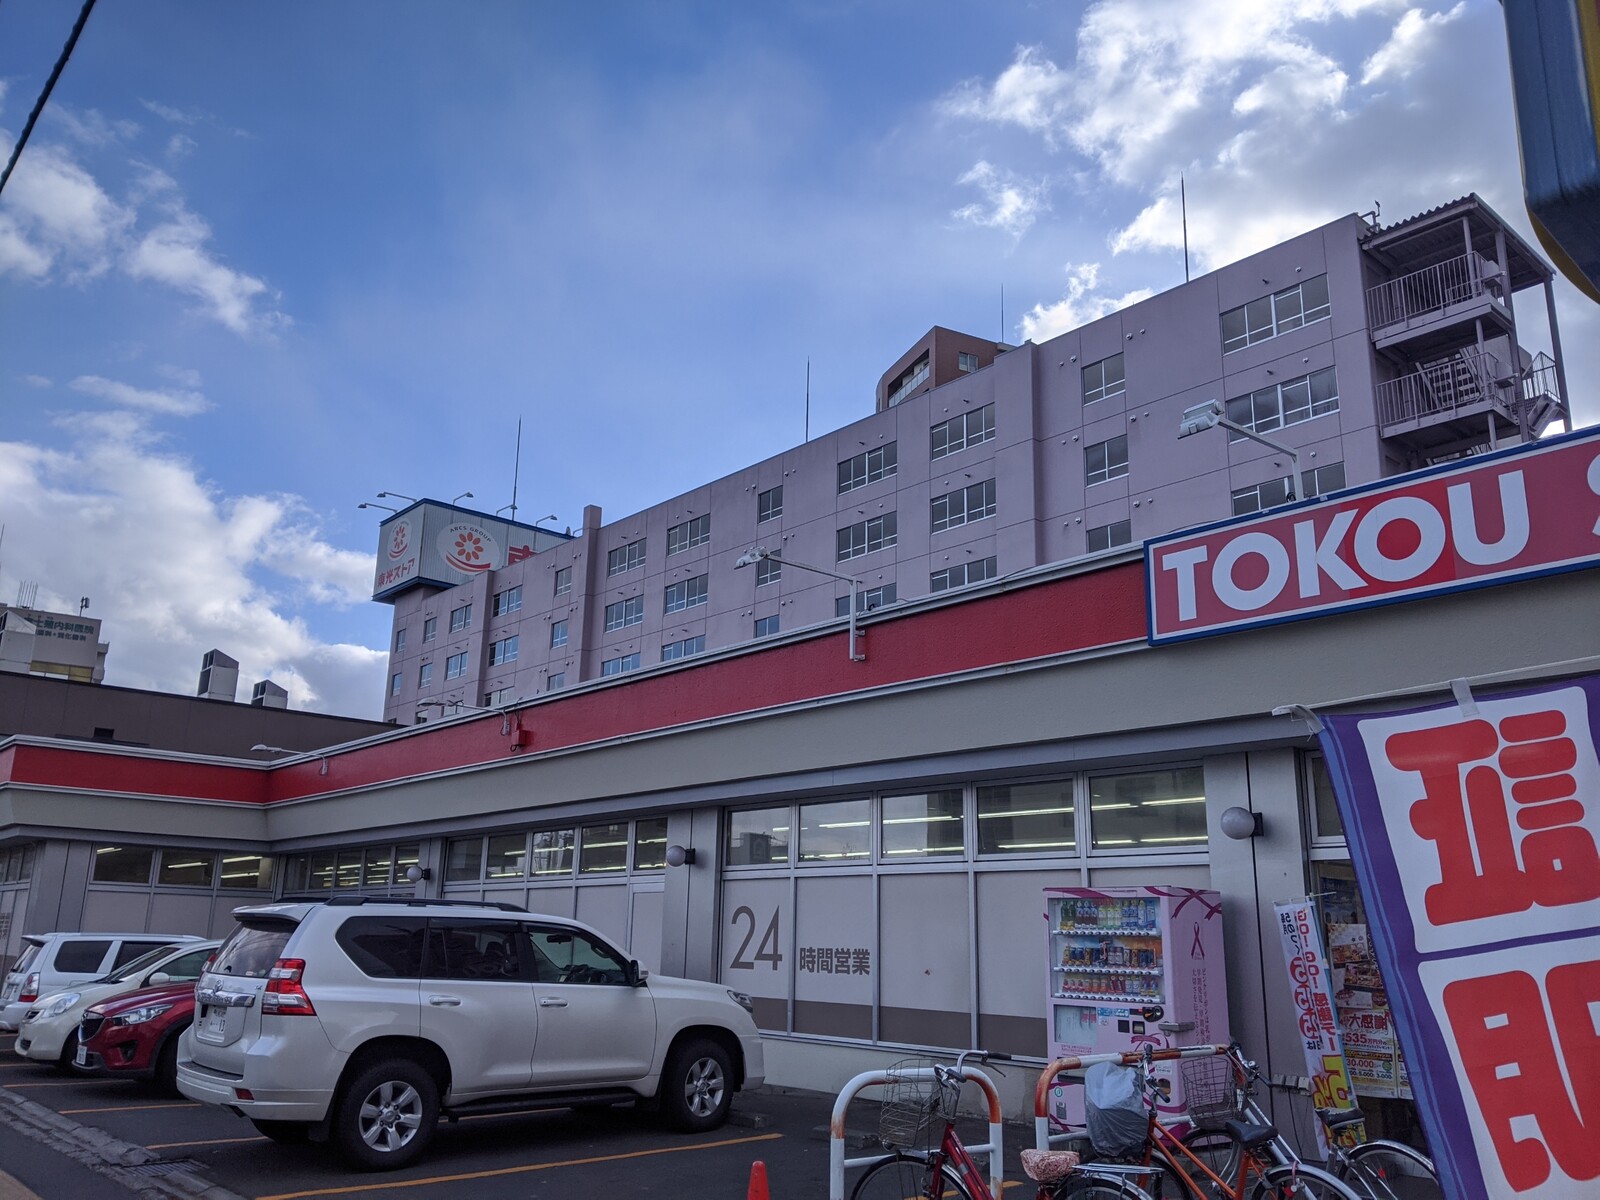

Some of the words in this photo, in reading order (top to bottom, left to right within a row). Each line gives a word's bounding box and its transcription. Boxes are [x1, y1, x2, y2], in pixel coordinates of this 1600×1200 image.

[450, 525, 467, 533] ARCS
[469, 526, 492, 542] GROUP
[1162, 469, 1530, 623] TOKOU
[377, 557, 416, 588] 東光ストア
[729, 905, 783, 971] 24
[799, 946, 871, 976] 時間営業
